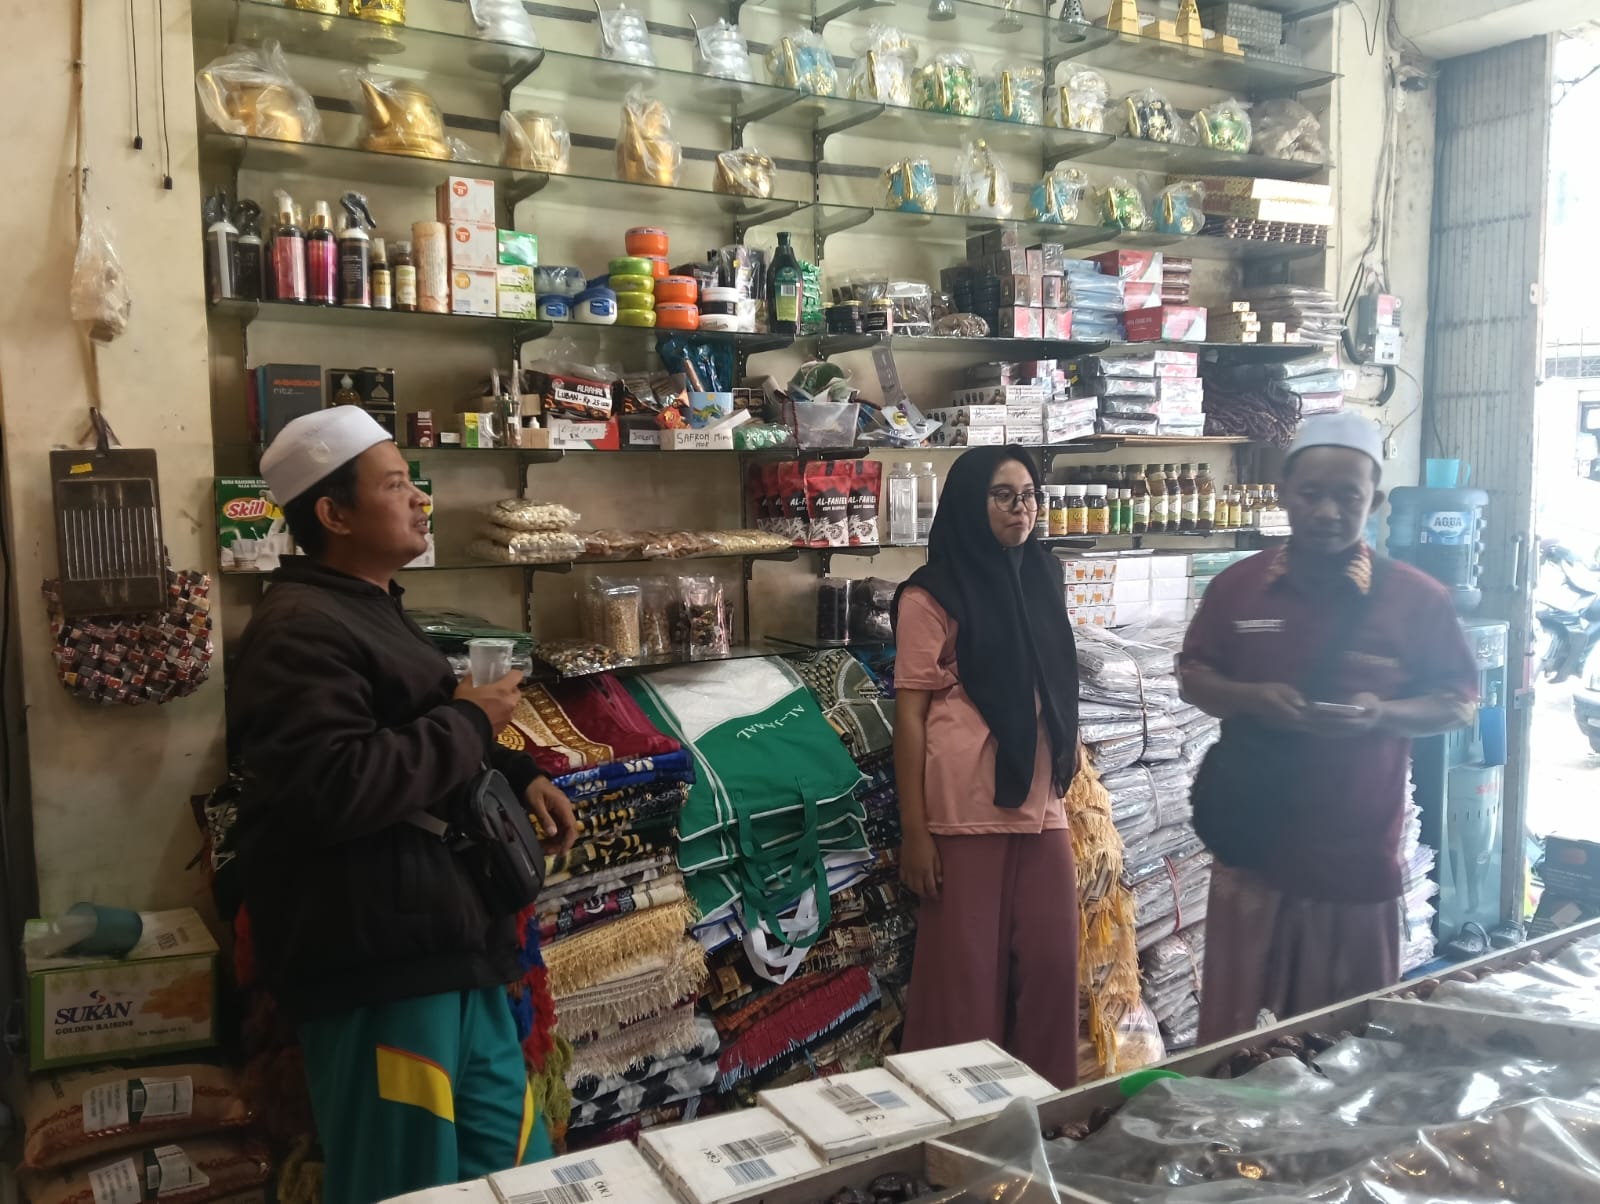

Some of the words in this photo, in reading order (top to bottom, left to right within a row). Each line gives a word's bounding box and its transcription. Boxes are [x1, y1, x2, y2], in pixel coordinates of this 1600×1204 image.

[227, 500, 266, 519] Skill
[1433, 517, 1462, 528] AQUA
[736, 705, 805, 739] AL-JAMAL
[54, 1000, 133, 1026] SUKAN
[54, 1023, 94, 1036] GOLDEN
